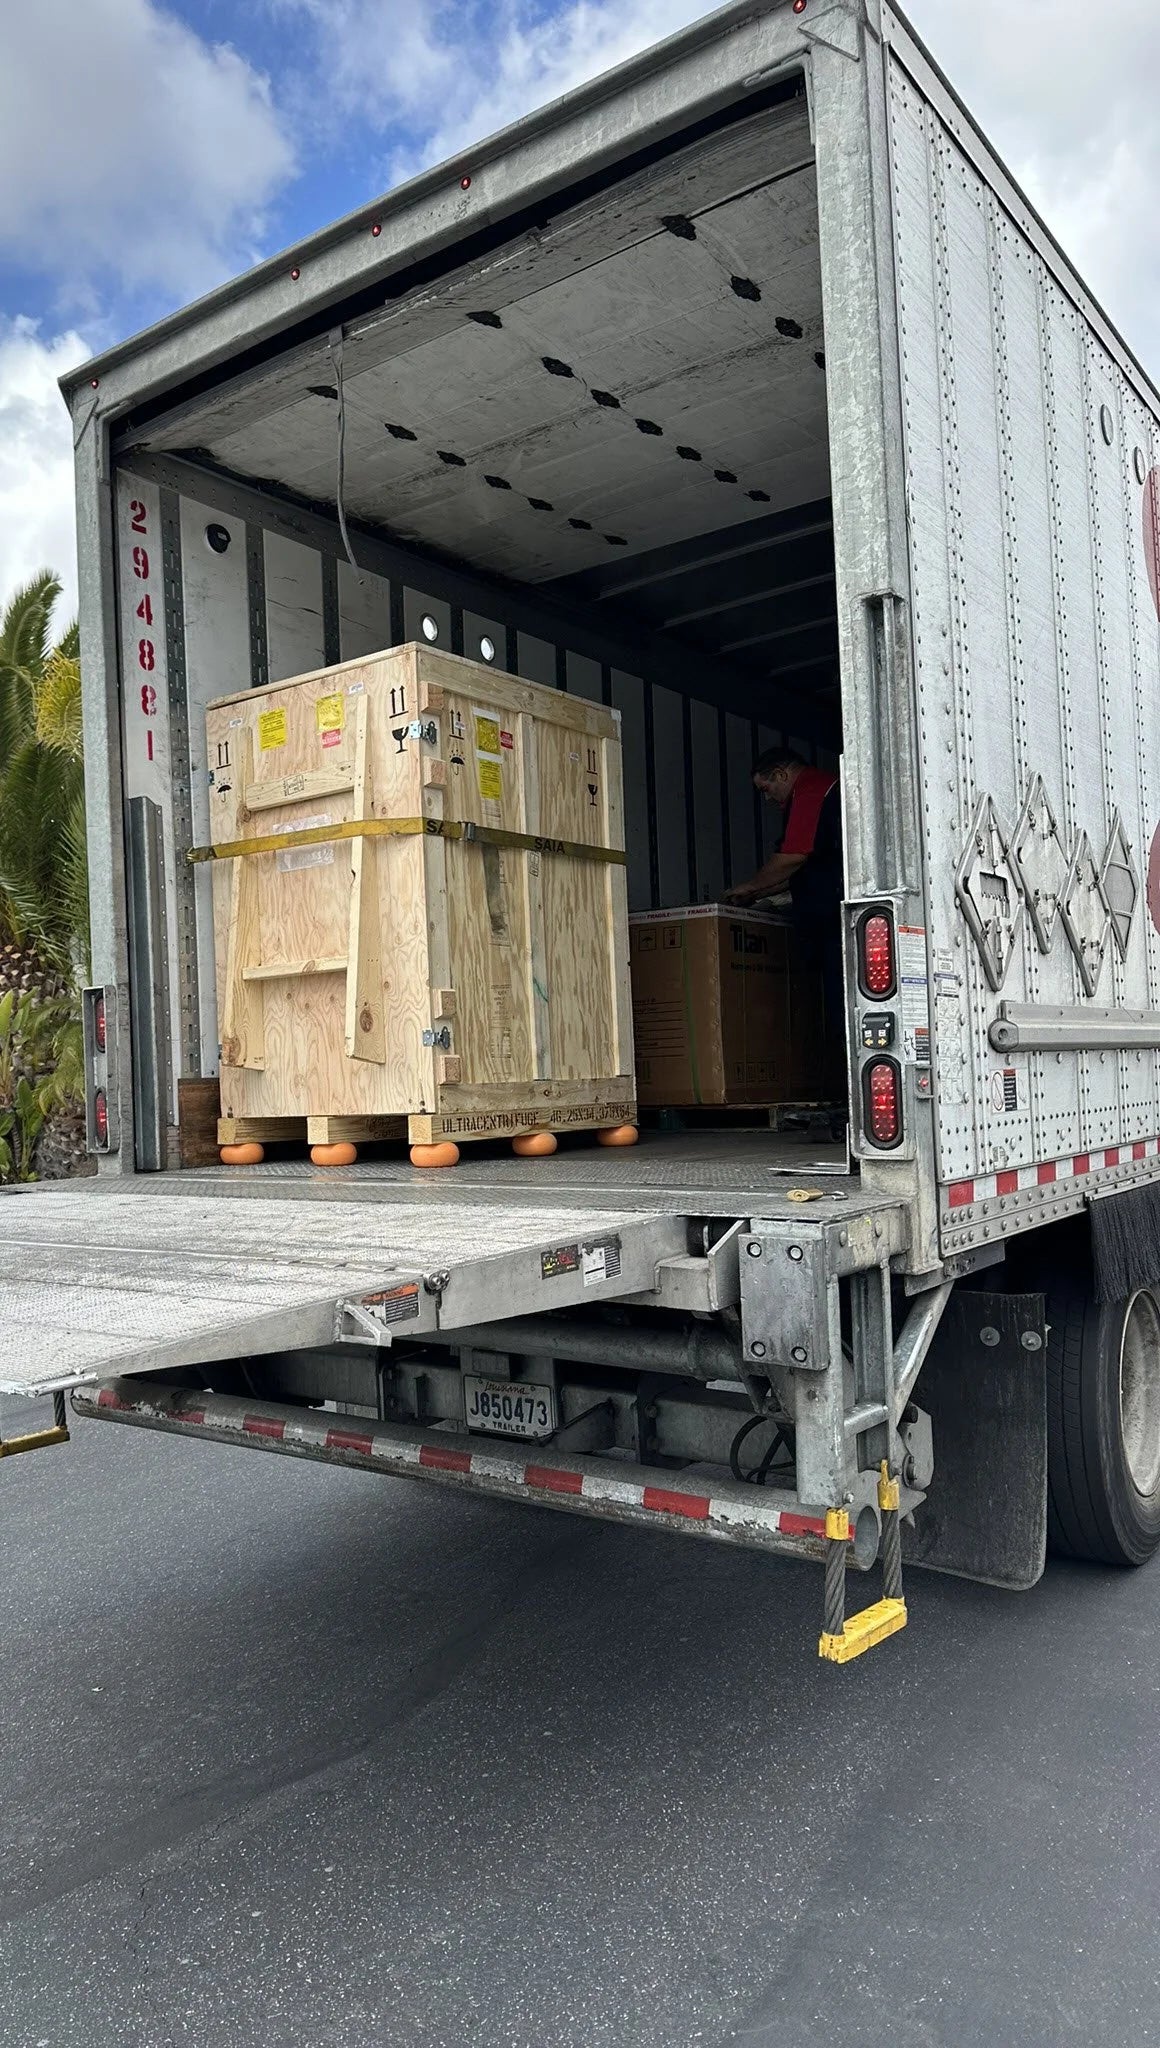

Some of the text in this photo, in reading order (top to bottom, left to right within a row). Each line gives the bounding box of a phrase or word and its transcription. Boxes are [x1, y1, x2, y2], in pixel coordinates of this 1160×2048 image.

[534, 837, 566, 854] SAIA
[687, 907, 712, 916] FRAGILE
[442, 1111, 539, 1133] ULTRACENTRIFUGE
[470, 1391, 547, 1426] J850473
[492, 1421, 526, 1433] TRAILER
